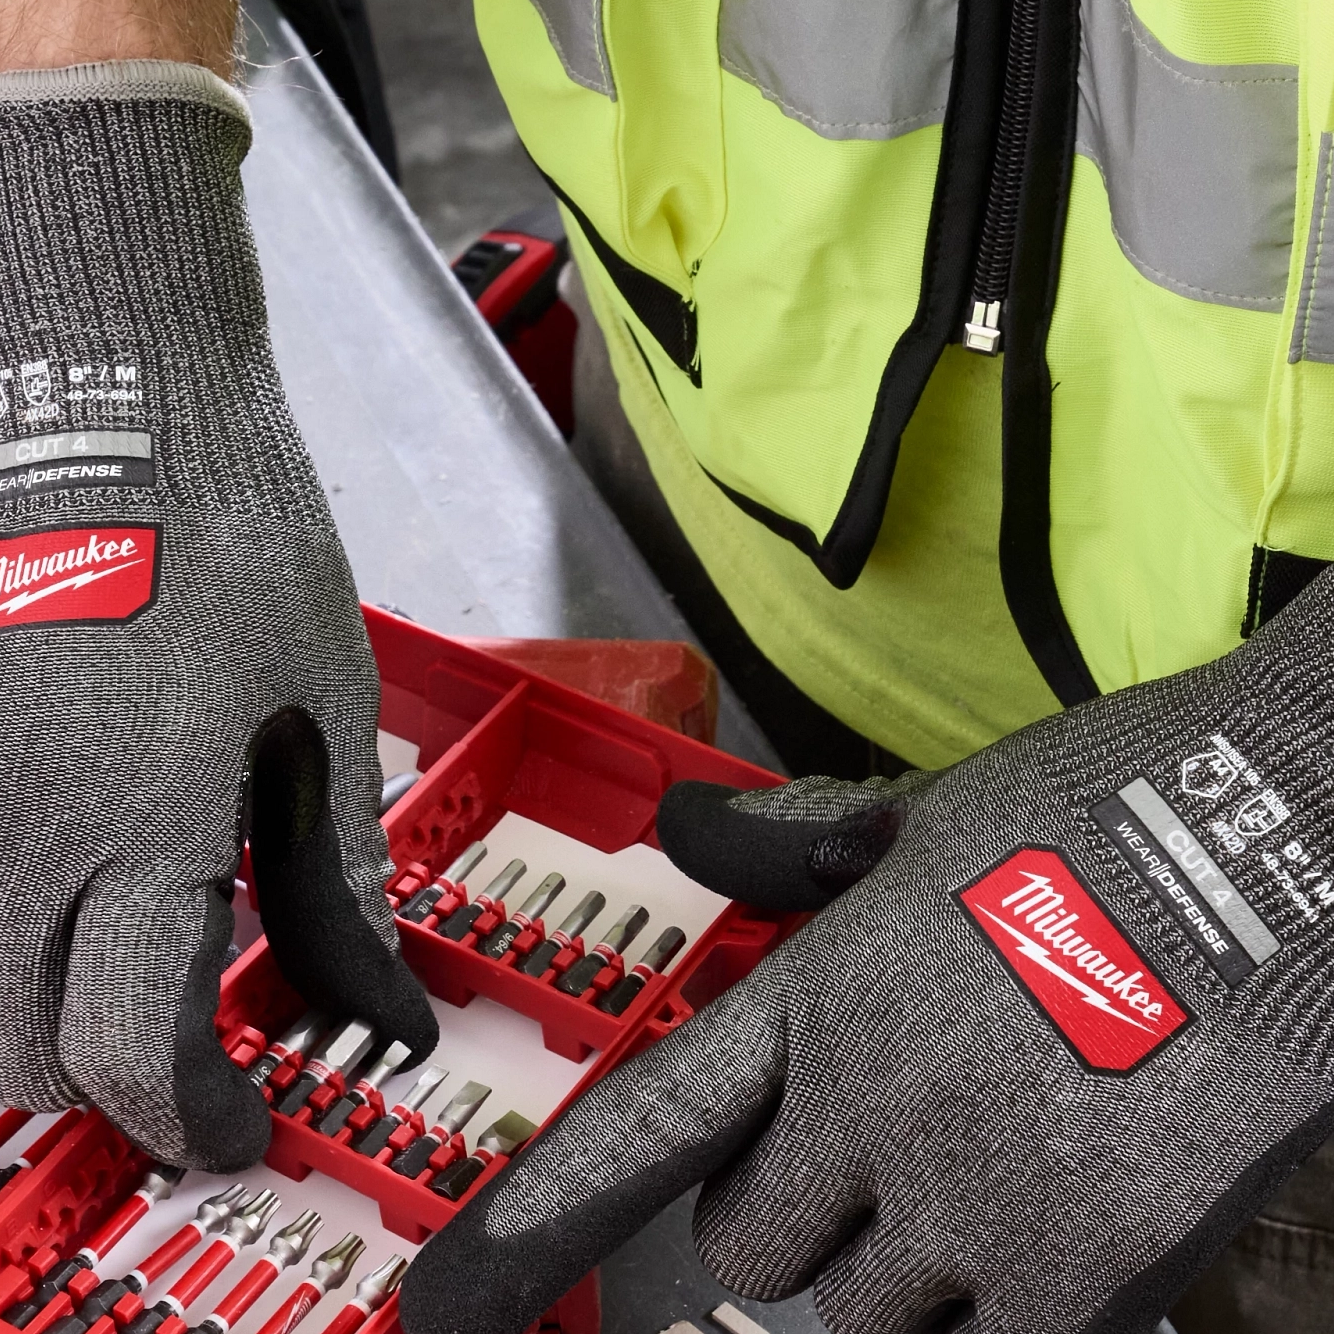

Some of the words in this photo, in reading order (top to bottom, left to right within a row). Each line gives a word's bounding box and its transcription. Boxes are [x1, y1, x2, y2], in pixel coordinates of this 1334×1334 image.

[21, 359, 48, 375] EN388
[116, 366, 136, 381] M
[66, 390, 143, 401] 48-73-6941
[15, 438, 63, 461] CUT
[72, 436, 88, 452] 4
[1209, 759, 1226, 776] A4
[1210, 734, 1246, 771] ANSI/ISEA
[1244, 768, 1261, 786] 105
[1262, 789, 1291, 819] EN388
[1212, 820, 1246, 855] 4X42D
[1164, 829, 1220, 885] CUT
[1212, 889, 1232, 908] 4
[1261, 852, 1320, 924] 48-73-6941
[1001, 869, 1165, 1022] Milwaukee
